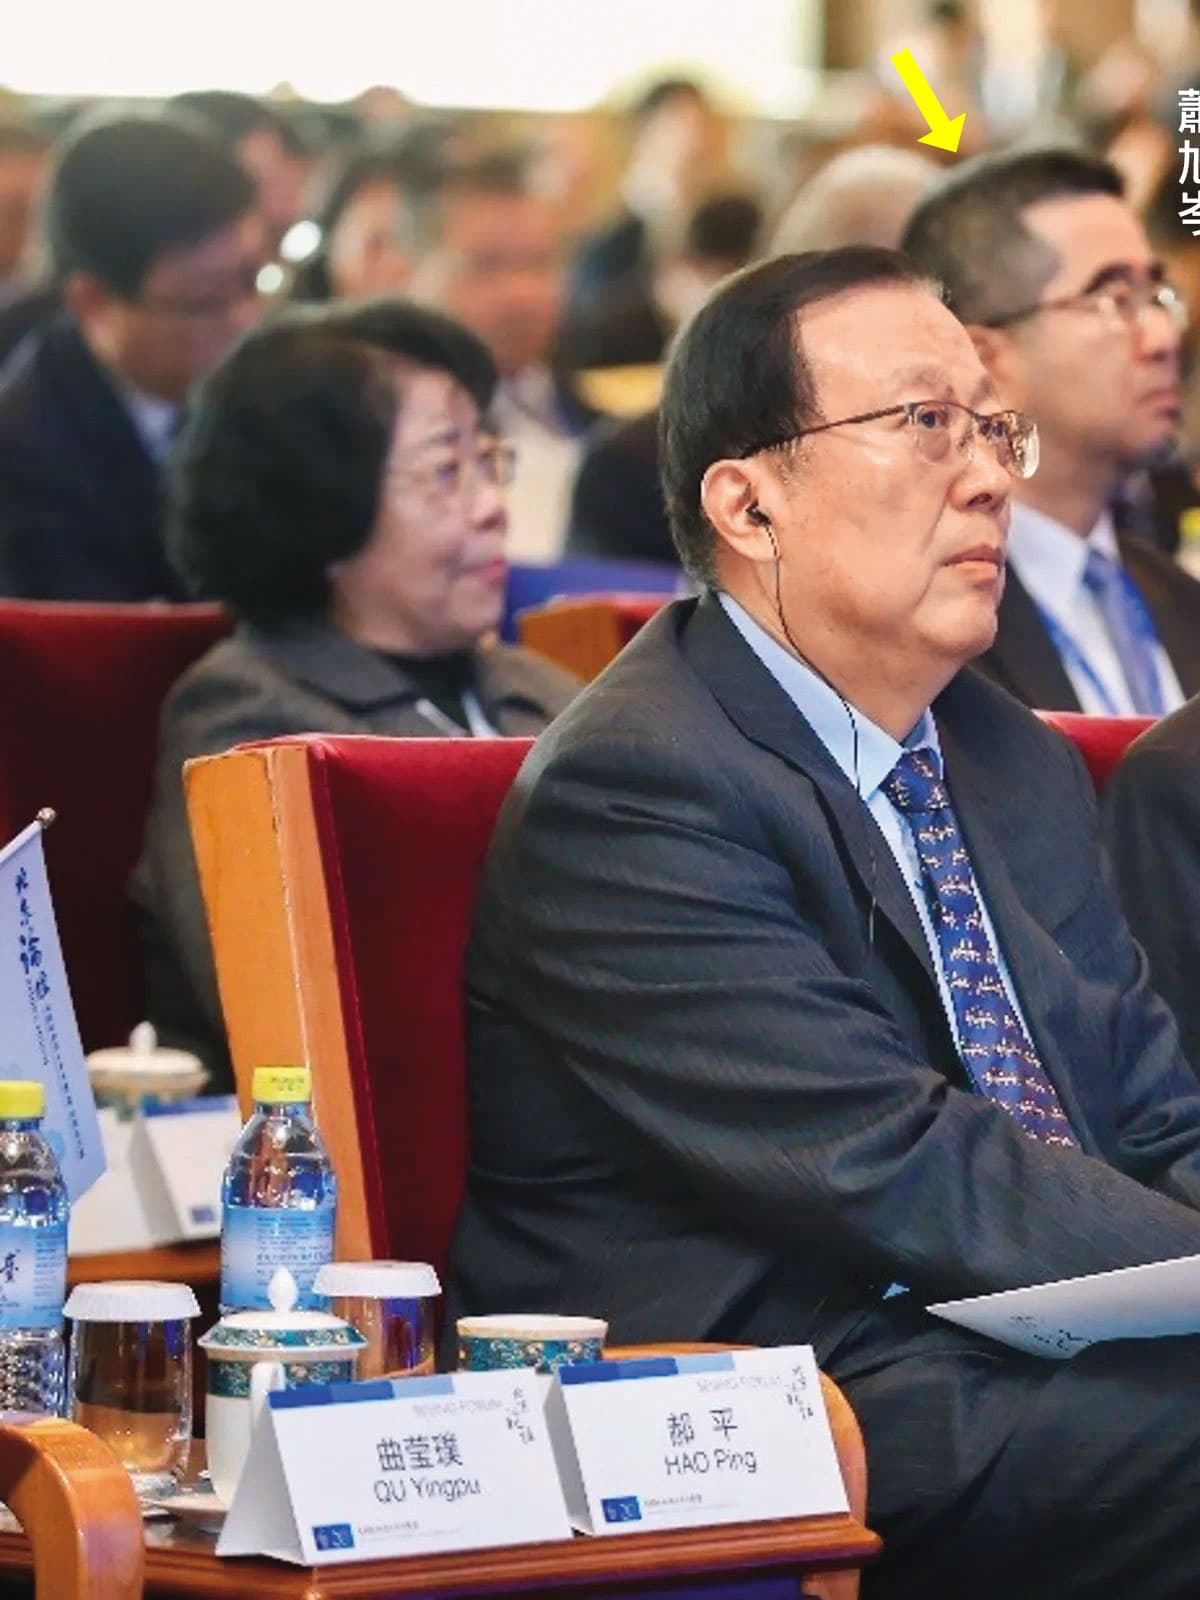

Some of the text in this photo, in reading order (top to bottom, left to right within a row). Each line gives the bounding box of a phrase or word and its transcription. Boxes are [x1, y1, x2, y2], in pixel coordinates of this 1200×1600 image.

[376, 1431, 463, 1472] 曲莹璞
[664, 1447, 758, 1476] HAO Ping
[373, 1475, 481, 1504] QU Yingpu
